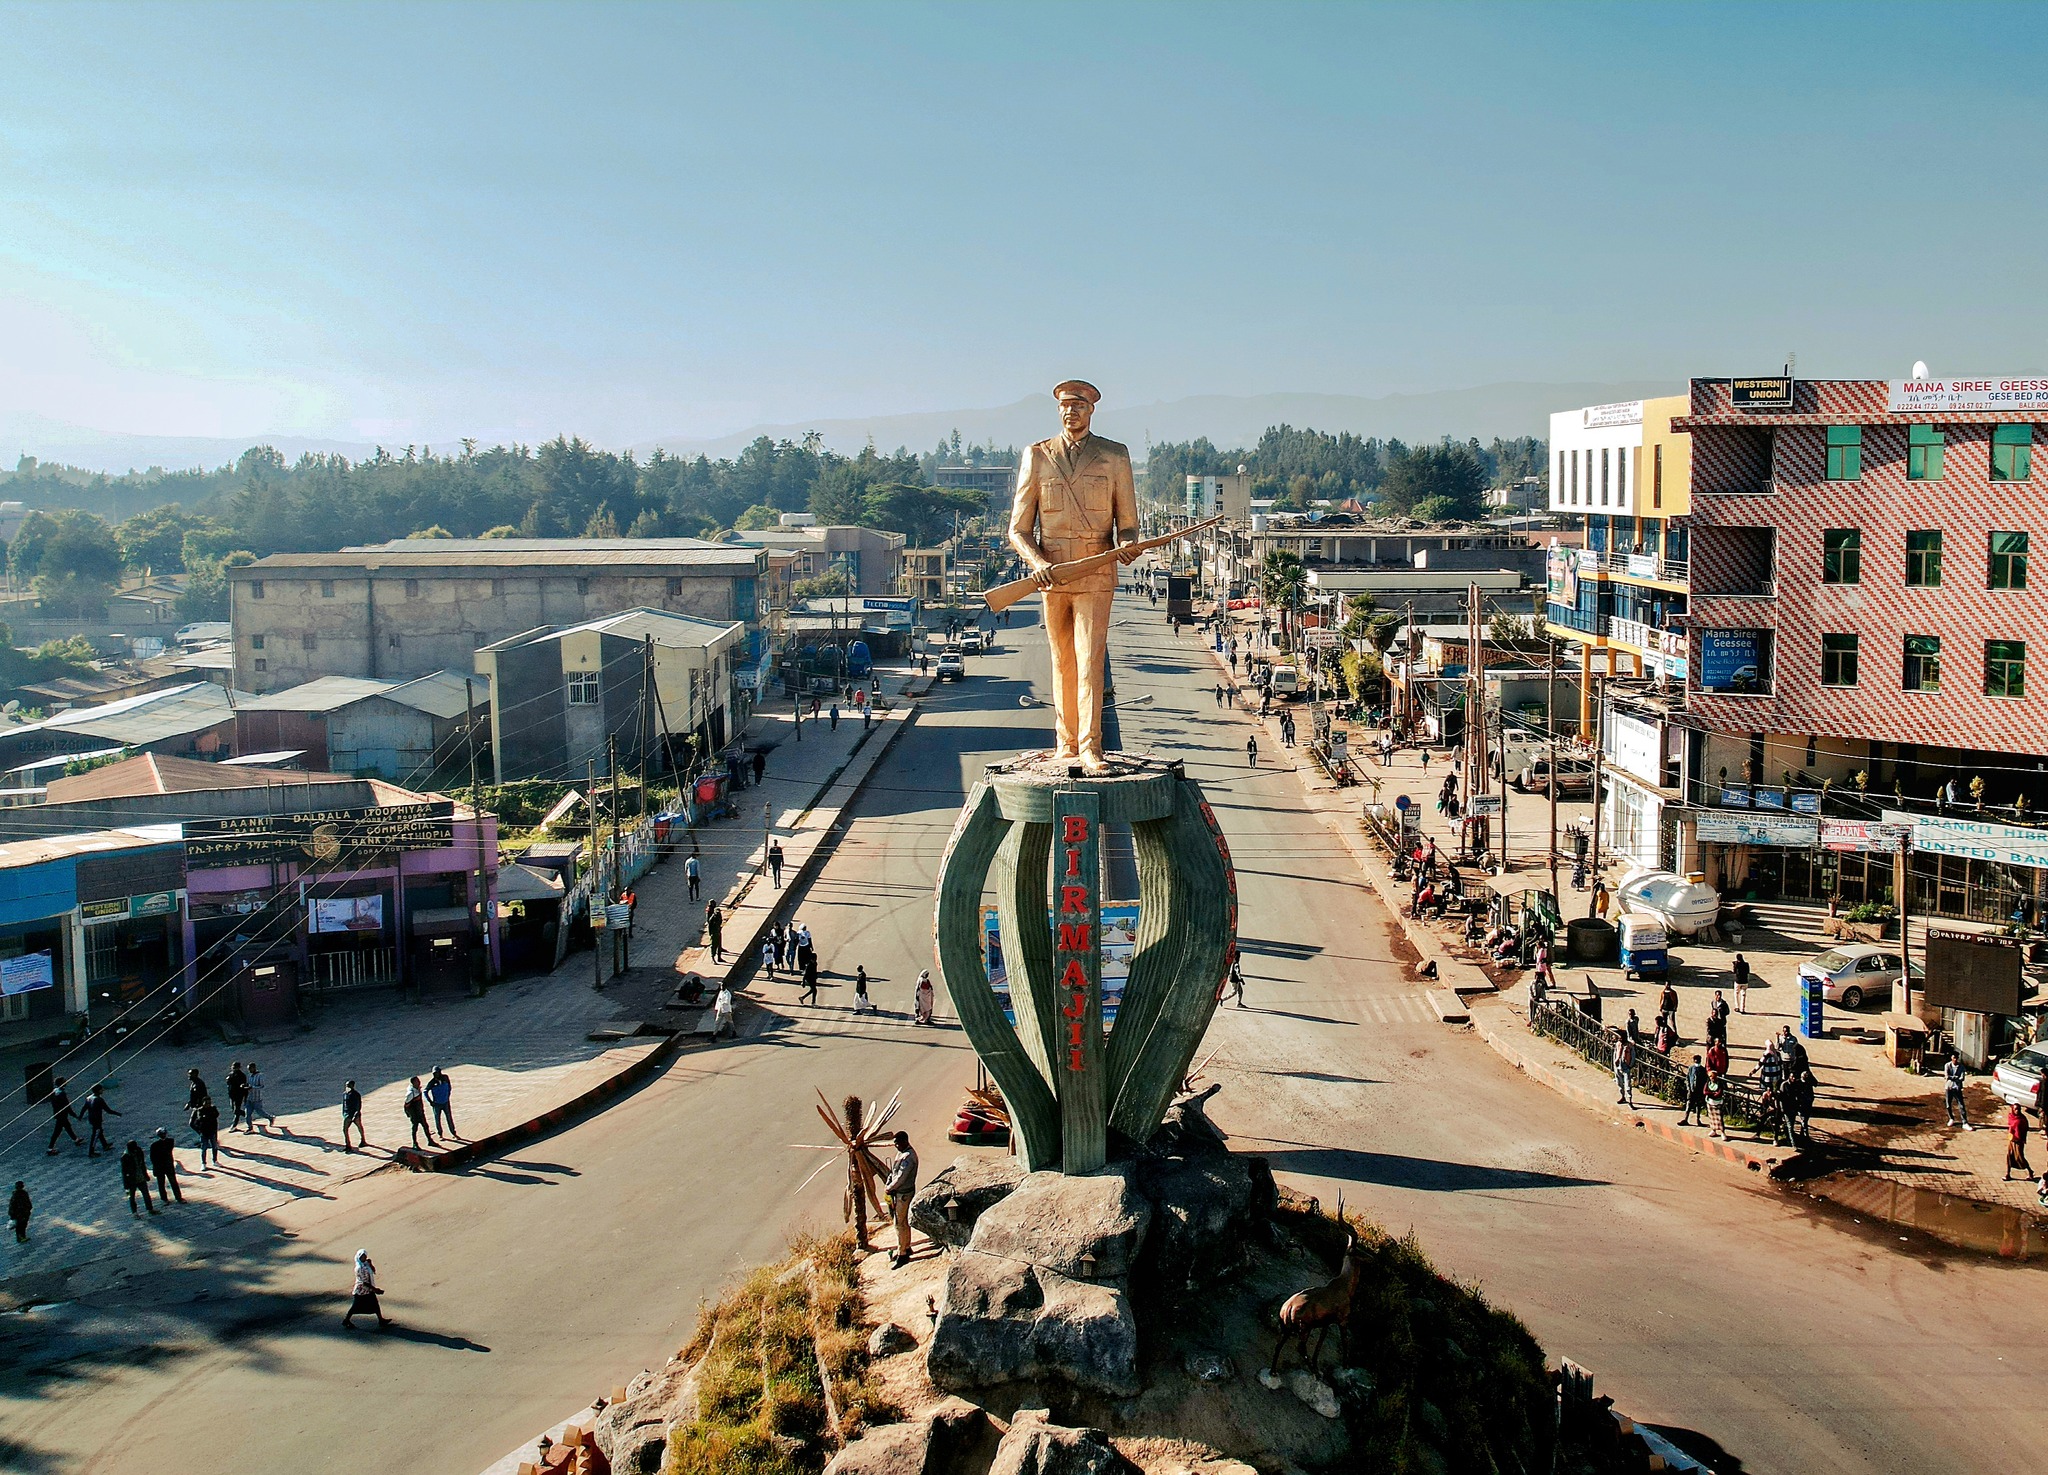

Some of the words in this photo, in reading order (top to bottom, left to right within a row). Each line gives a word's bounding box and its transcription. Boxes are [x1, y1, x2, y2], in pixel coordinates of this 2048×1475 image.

[1734, 381, 1780, 389] WESTERN
[1903, 382, 1945, 393] MANA
[1952, 381, 1992, 392] SIREE
[1749, 390, 1780, 399] UNION
[1988, 392, 2012, 401] GESE
[2015, 392, 2033, 401] BED
[1705, 630, 1730, 638] Mana
[1733, 629, 1757, 638] Siree
[1713, 639, 1752, 648] Geessee
[293, 810, 351, 823] DALDALA
[364, 805, 433, 817] ITOOPHIYAA
[366, 823, 436, 835] COMMERCIAL
[1919, 818, 1993, 835] BAANKII
[351, 837, 381, 846] BANK
[385, 835, 397, 843] OF
[401, 830, 452, 842] ETHIOPIA
[1919, 839, 1996, 859] UNITED
[2010, 852, 2048, 866] BAN
[83, 902, 119, 912] WESTERN
[95, 907, 120, 916] UNION
[1058, 815, 1091, 1072] BIRMAJII
